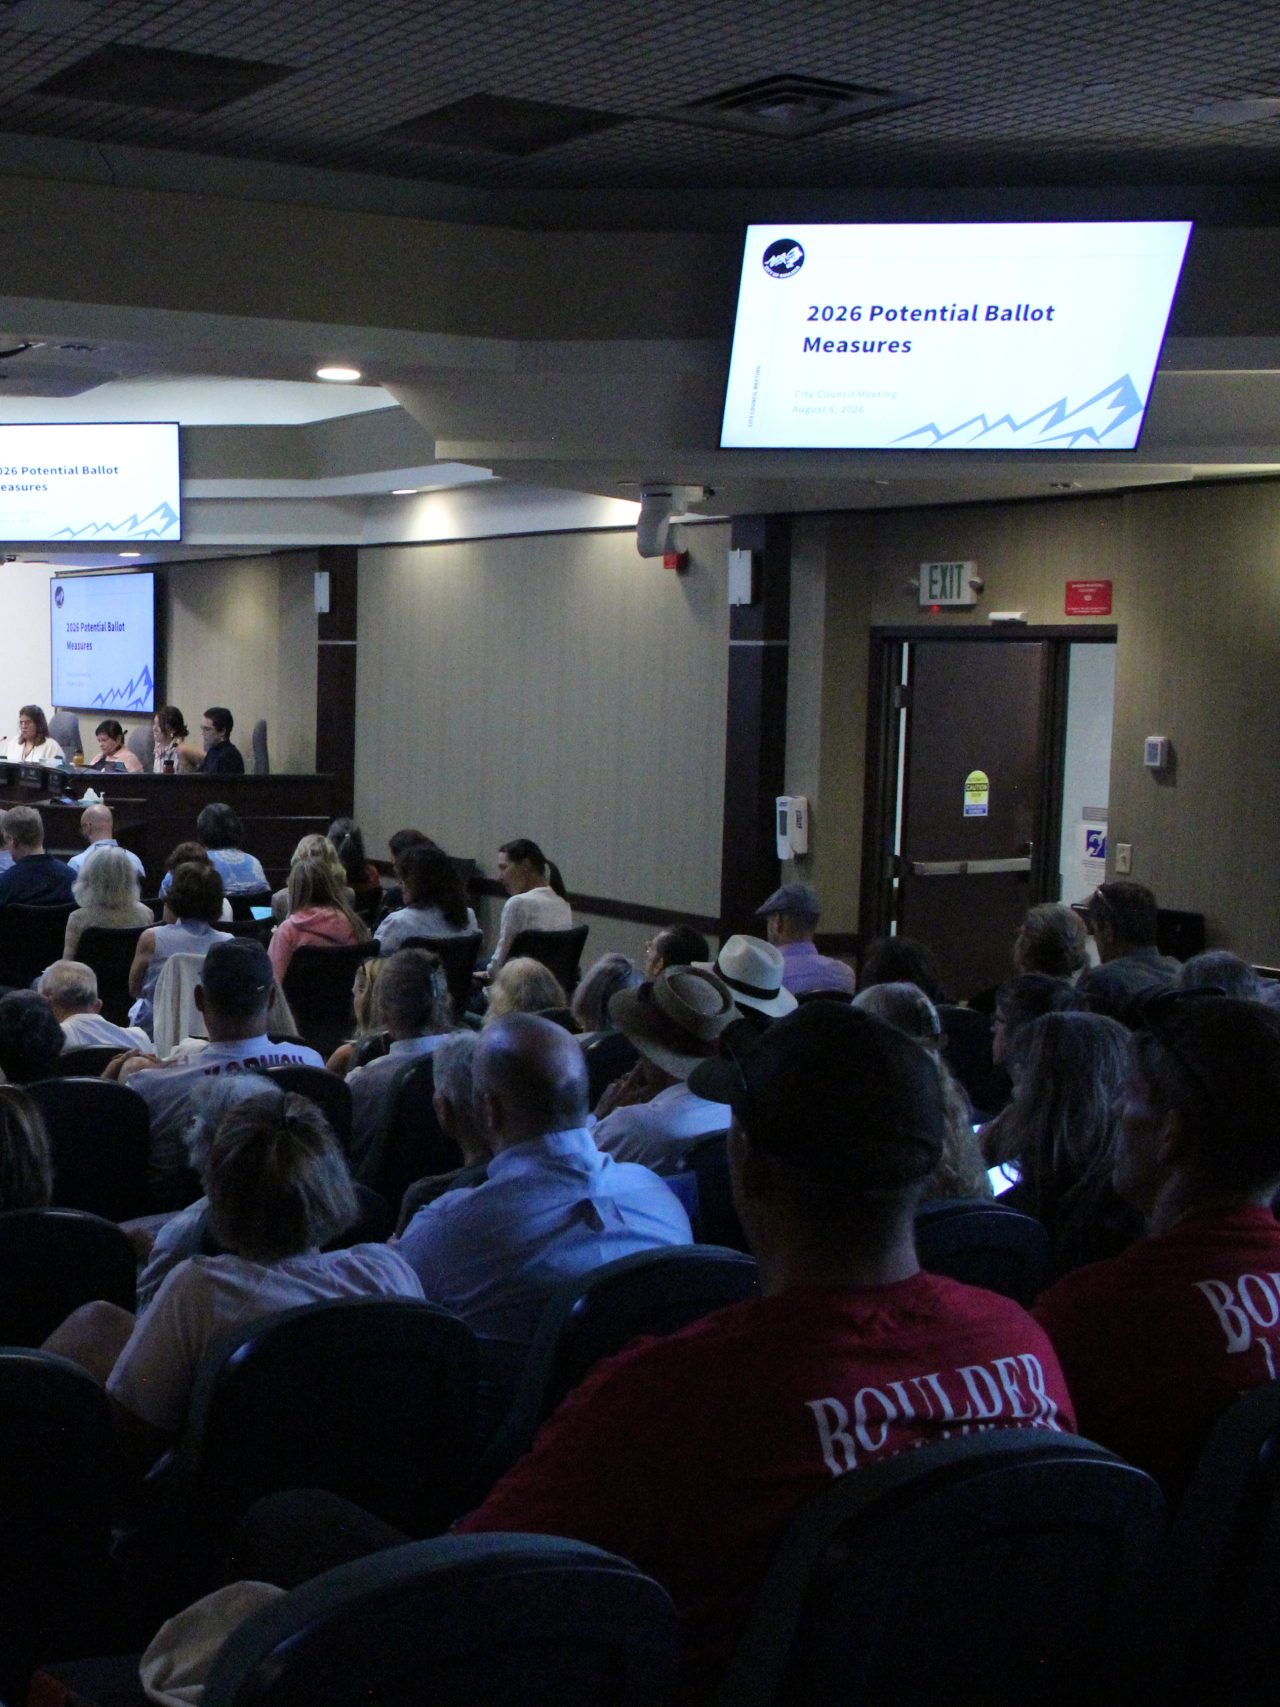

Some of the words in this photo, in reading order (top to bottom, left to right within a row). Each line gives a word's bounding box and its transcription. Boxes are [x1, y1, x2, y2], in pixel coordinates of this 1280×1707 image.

[806, 305, 862, 321] 2026
[869, 304, 979, 321] Potential
[984, 304, 1055, 321] Ballot
[802, 336, 912, 353] Measures
[21, 465, 79, 476] Potential
[82, 465, 119, 475] Ballot
[929, 564, 964, 599] EXIT
[81, 621, 106, 632] Potential
[107, 621, 125, 632] Ballot
[66, 641, 92, 651] Measures
[804, 1353, 1061, 1478] BOULDER
